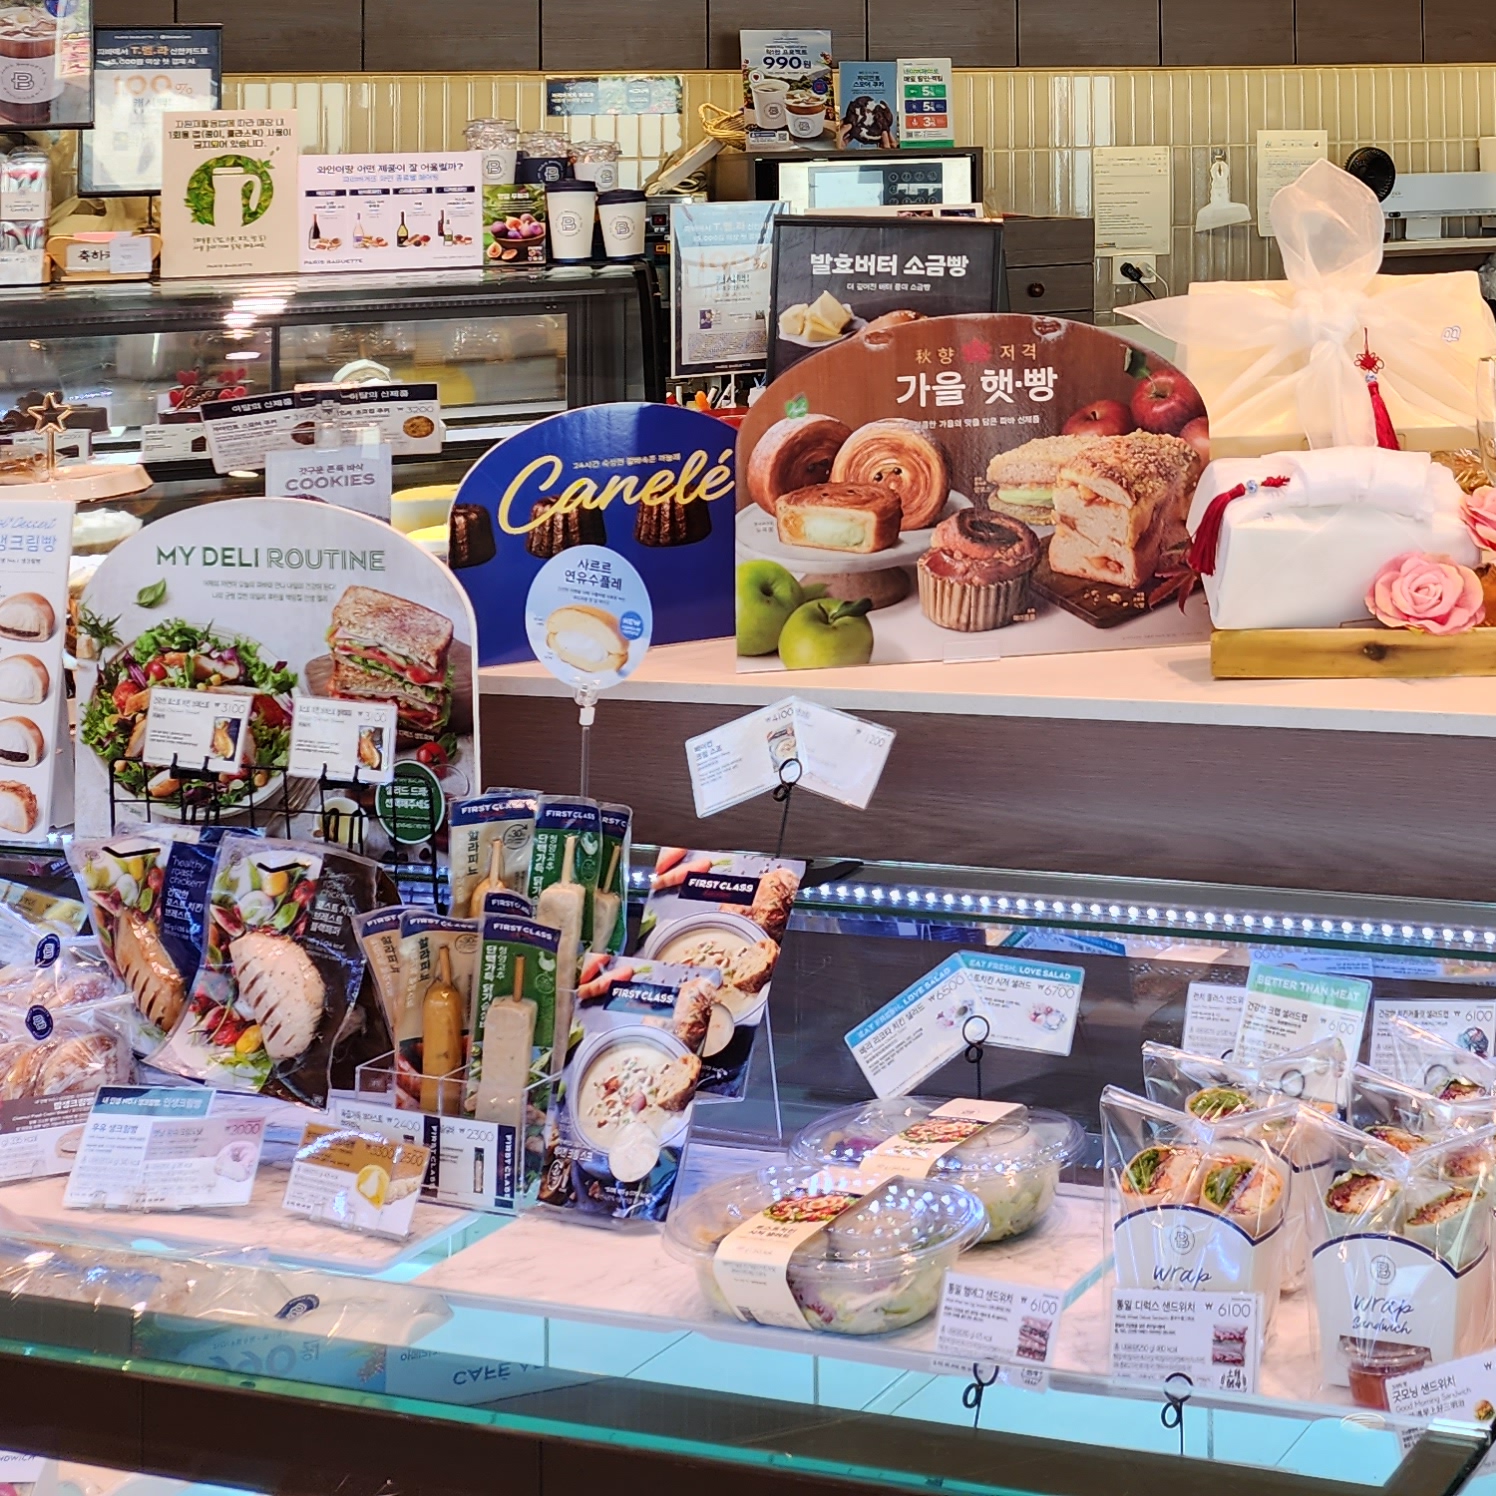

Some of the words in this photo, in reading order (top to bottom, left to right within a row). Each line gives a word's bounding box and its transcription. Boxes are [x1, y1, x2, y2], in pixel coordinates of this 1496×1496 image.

[810, 252, 898, 277] 발효버터
[903, 254, 969, 278] 소금빵
[896, 371, 966, 408] 가을
[285, 473, 376, 492] COOKIES
[497, 448, 736, 535] Canelé
[156, 545, 197, 566] MY
[202, 546, 260, 569] DELI
[266, 548, 386, 572] ROUTINE
[577, 558, 612, 575] 사르르
[564, 570, 623, 592] 연유수플레
[461, 803, 490, 815] FIRST
[545, 808, 573, 819] FIRST
[573, 810, 596, 821] CLASS
[687, 877, 720, 890] FIRST
[720, 880, 754, 894] CLASS
[408, 917, 440, 927] FIRST
[493, 922, 522, 933] FIRST
[522, 926, 553, 941] CLASS
[1019, 965, 1041, 977] LOVE
[1042, 968, 1072, 982] SALAD
[612, 986, 643, 1002] FIRST
[642, 990, 675, 1005] CLASS
[902, 986, 925, 1007] LOVE
[923, 967, 951, 992] SALAD
[1256, 974, 1298, 991] BETTER
[1299, 981, 1329, 995] THAN
[1329, 987, 1361, 1002] MEAT
[1152, 1265, 1213, 1285] wrap
[985, 1289, 1015, 1304] 샌드위치
[1353, 1293, 1416, 1316] wrap
[1116, 1299, 1133, 1312] 통밀
[1135, 1300, 1160, 1312] 디럭스
[1161, 1300, 1197, 1314] 샌드위치
[1351, 1315, 1413, 1336] Sandwich
[1391, 1385, 1420, 1406] 굿모닝
[1419, 1374, 1457, 1397] 샌드위치
